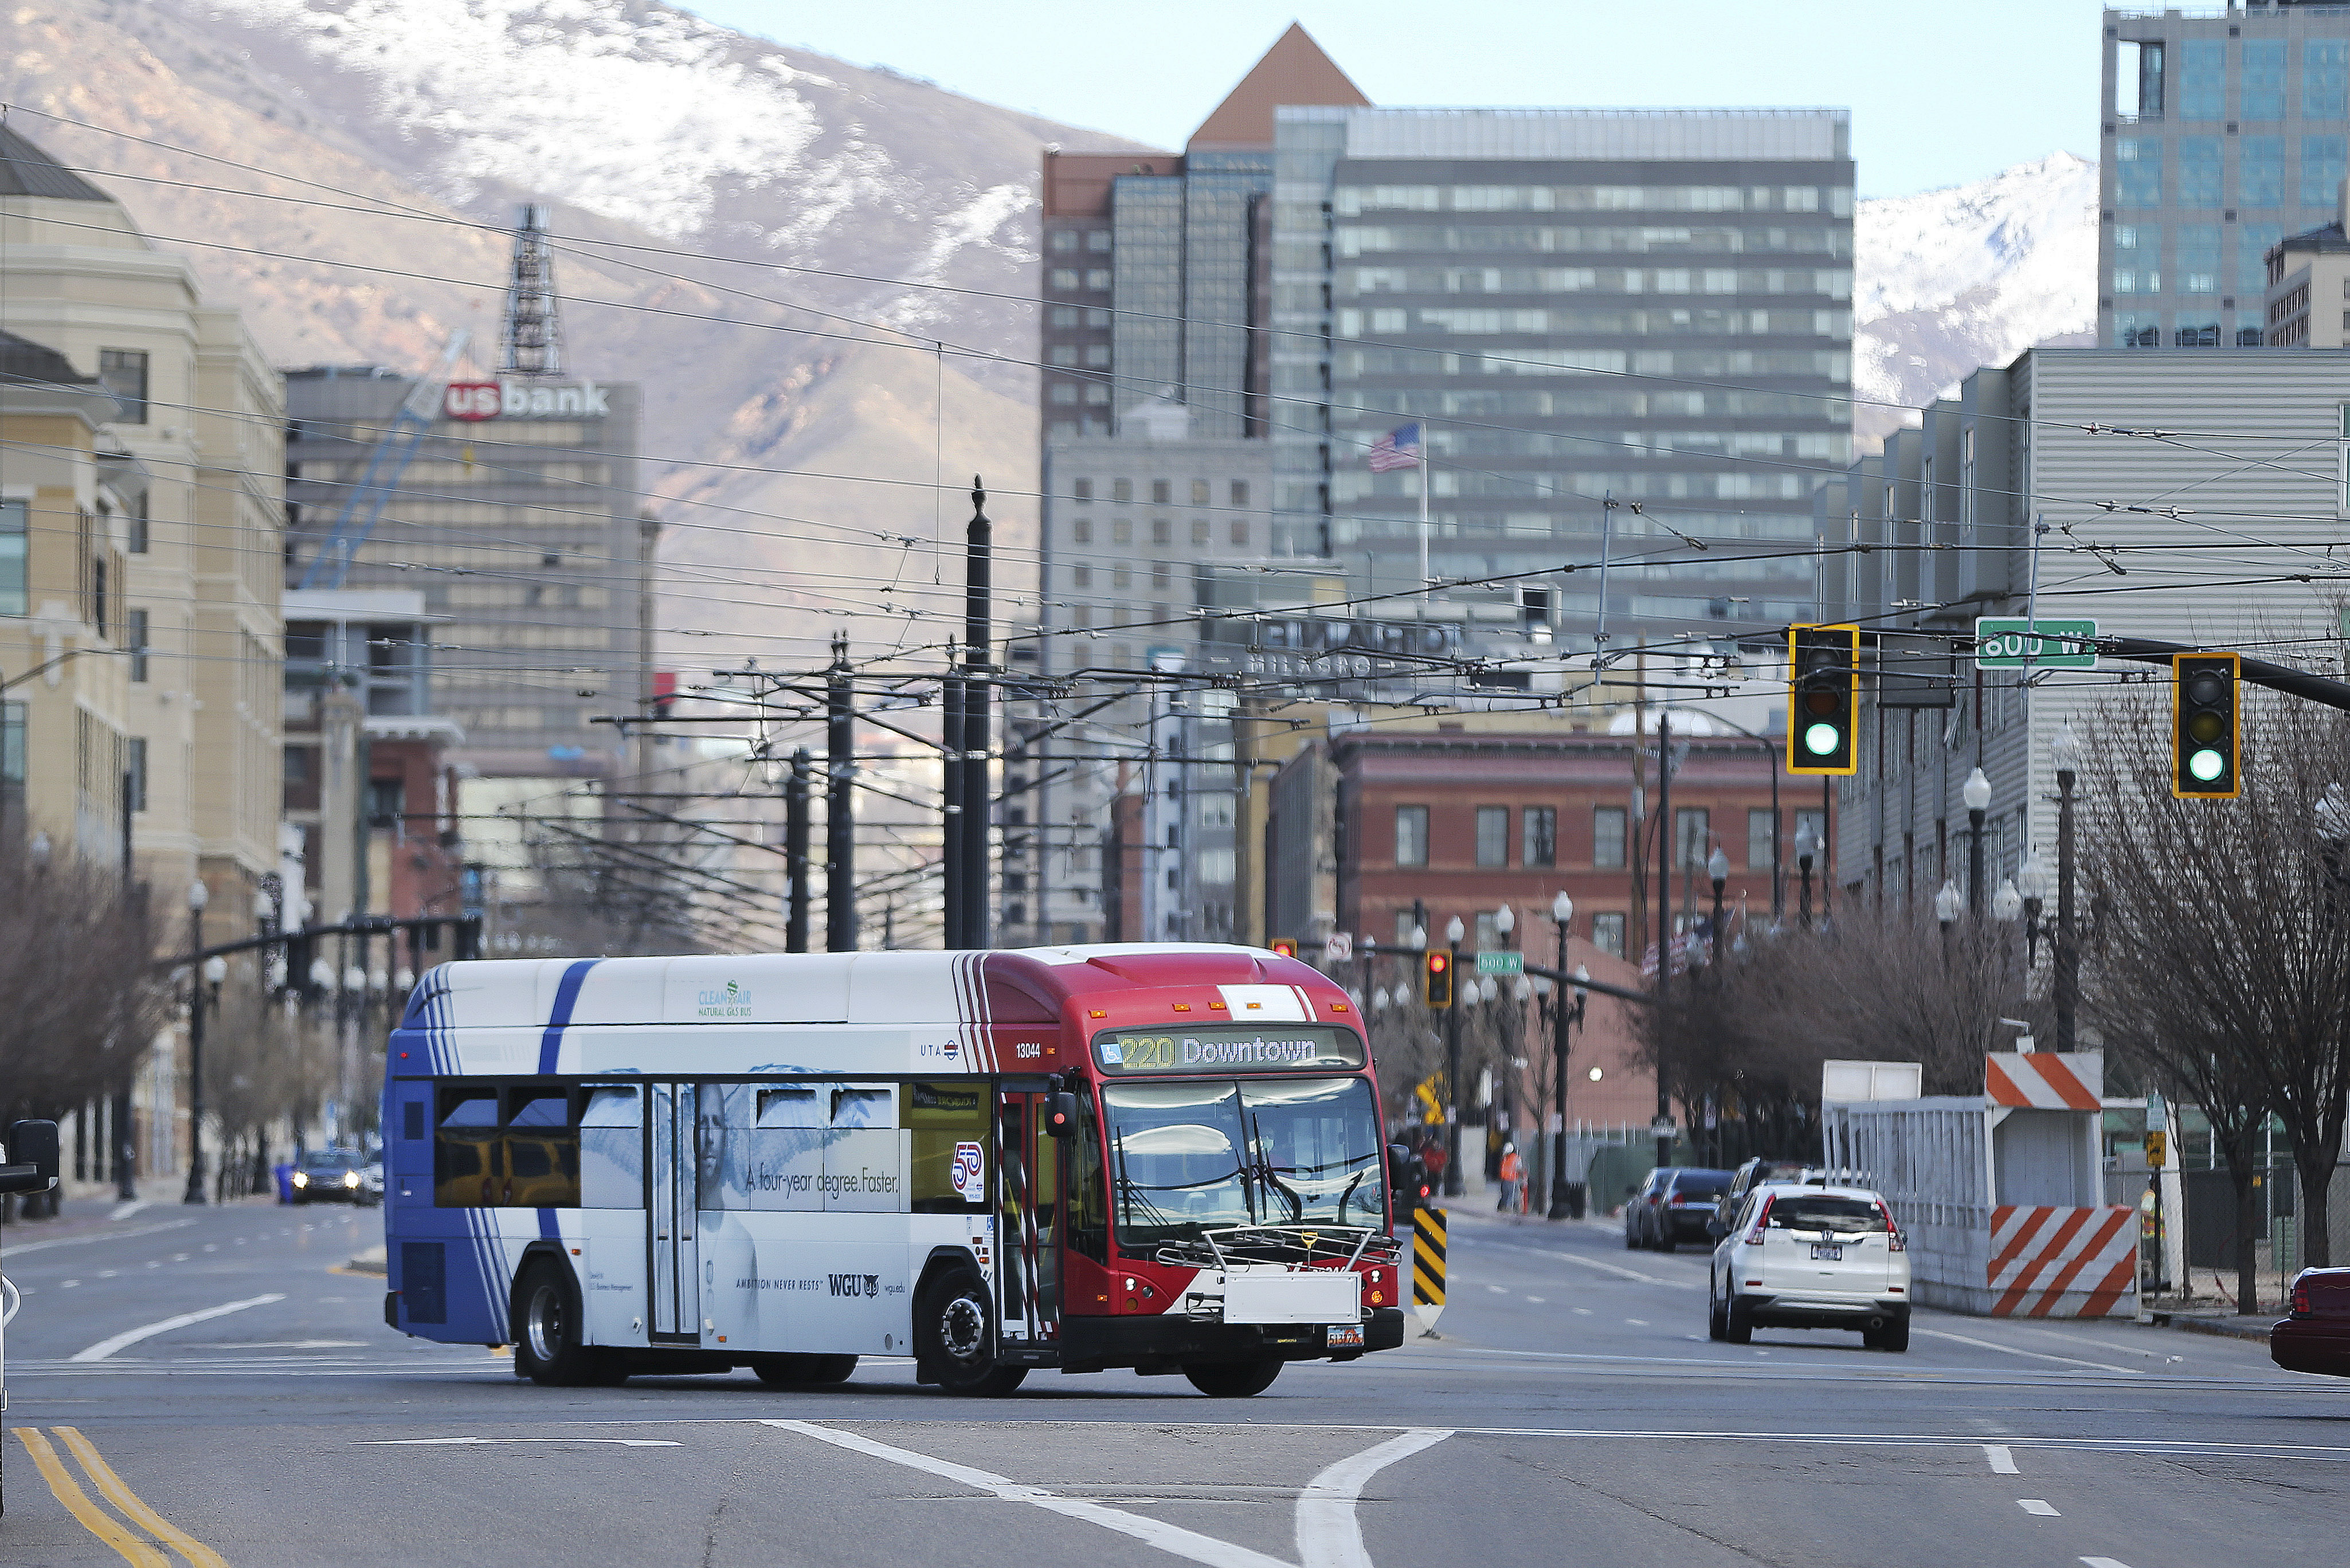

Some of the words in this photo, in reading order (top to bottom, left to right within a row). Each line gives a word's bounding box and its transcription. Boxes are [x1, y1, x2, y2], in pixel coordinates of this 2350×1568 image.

[1509, 957, 1518, 969] W
[699, 990, 727, 1005] CLEAN
[737, 990, 752, 1005] AIR
[699, 1007, 726, 1017] NATURAL
[727, 1007, 739, 1016] GAS
[741, 1006, 752, 1016] BUS
[921, 1045, 941, 1056] UTA
[1016, 1042, 1041, 1059] 13044
[1120, 1037, 1176, 1068] 220
[1183, 1036, 1317, 1064] Downtown
[953, 1144, 981, 1190] 50
[745, 1166, 756, 1191] A
[760, 1162, 813, 1199] four-year
[862, 1167, 899, 1194] Faster.
[737, 1278, 771, 1289] AMBITION
[774, 1279, 797, 1290] NEVER
[828, 1274, 862, 1296] WGU
[884, 1281, 906, 1296] wgu.edu
